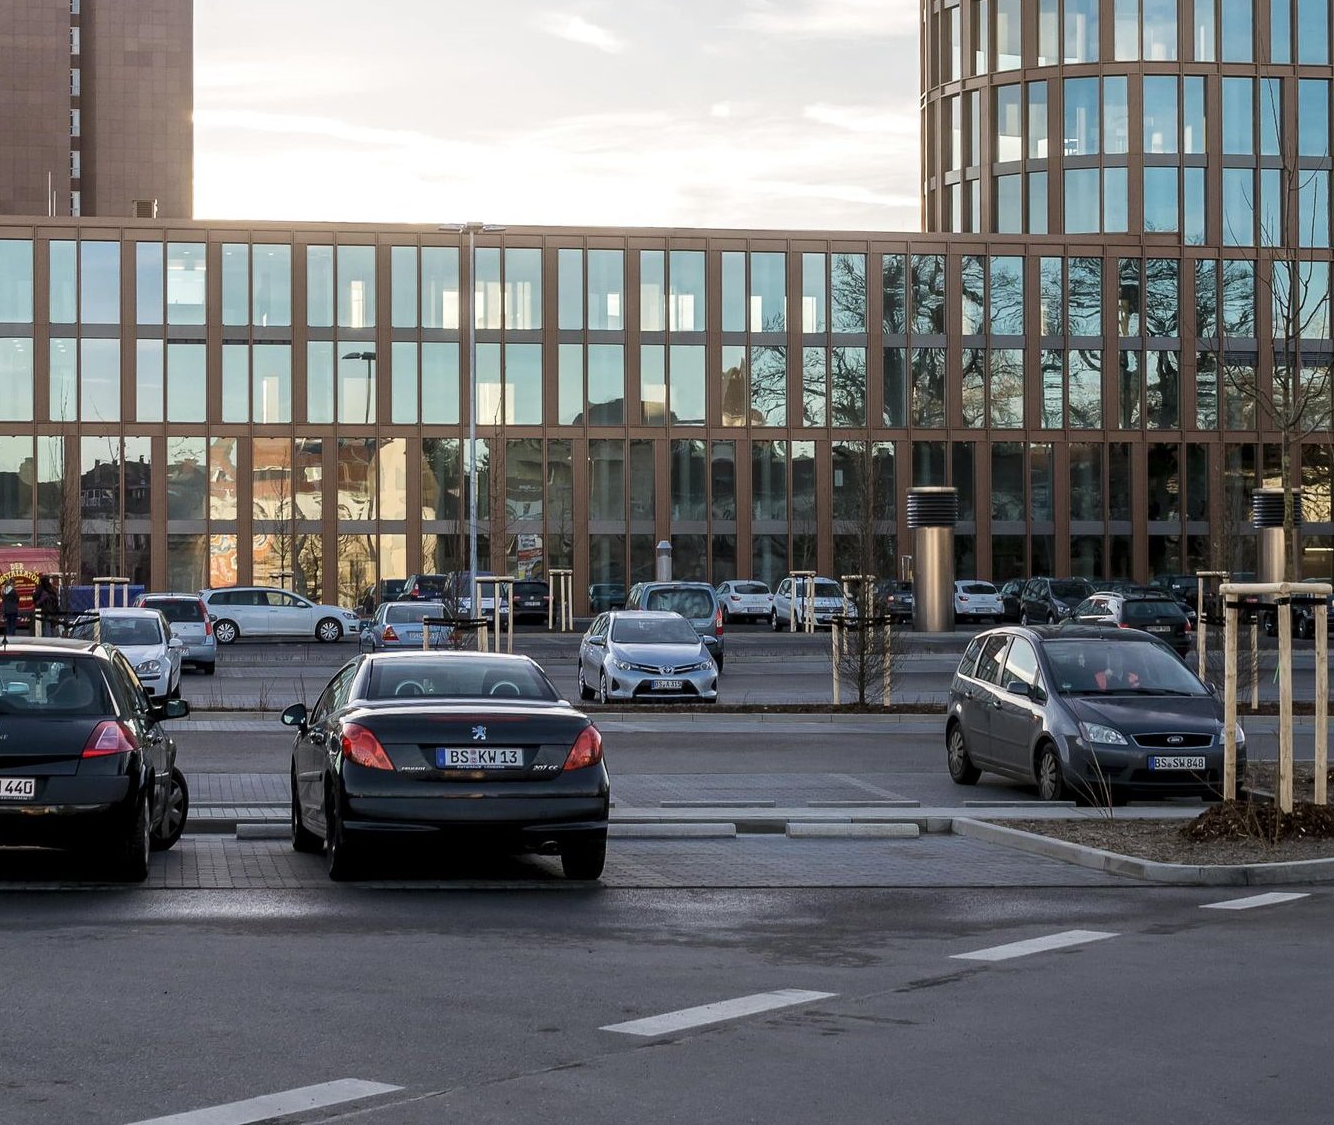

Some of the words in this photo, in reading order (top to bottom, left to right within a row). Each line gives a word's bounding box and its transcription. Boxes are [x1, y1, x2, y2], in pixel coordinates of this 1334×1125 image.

[9, 562, 25, 571] DER
[450, 750, 469, 764] BS
[478, 750, 497, 764] KW
[500, 750, 518, 764] 13
[1154, 758, 1167, 768] BS
[1187, 758, 1204, 768] 848
[4, 780, 33, 795] 440
